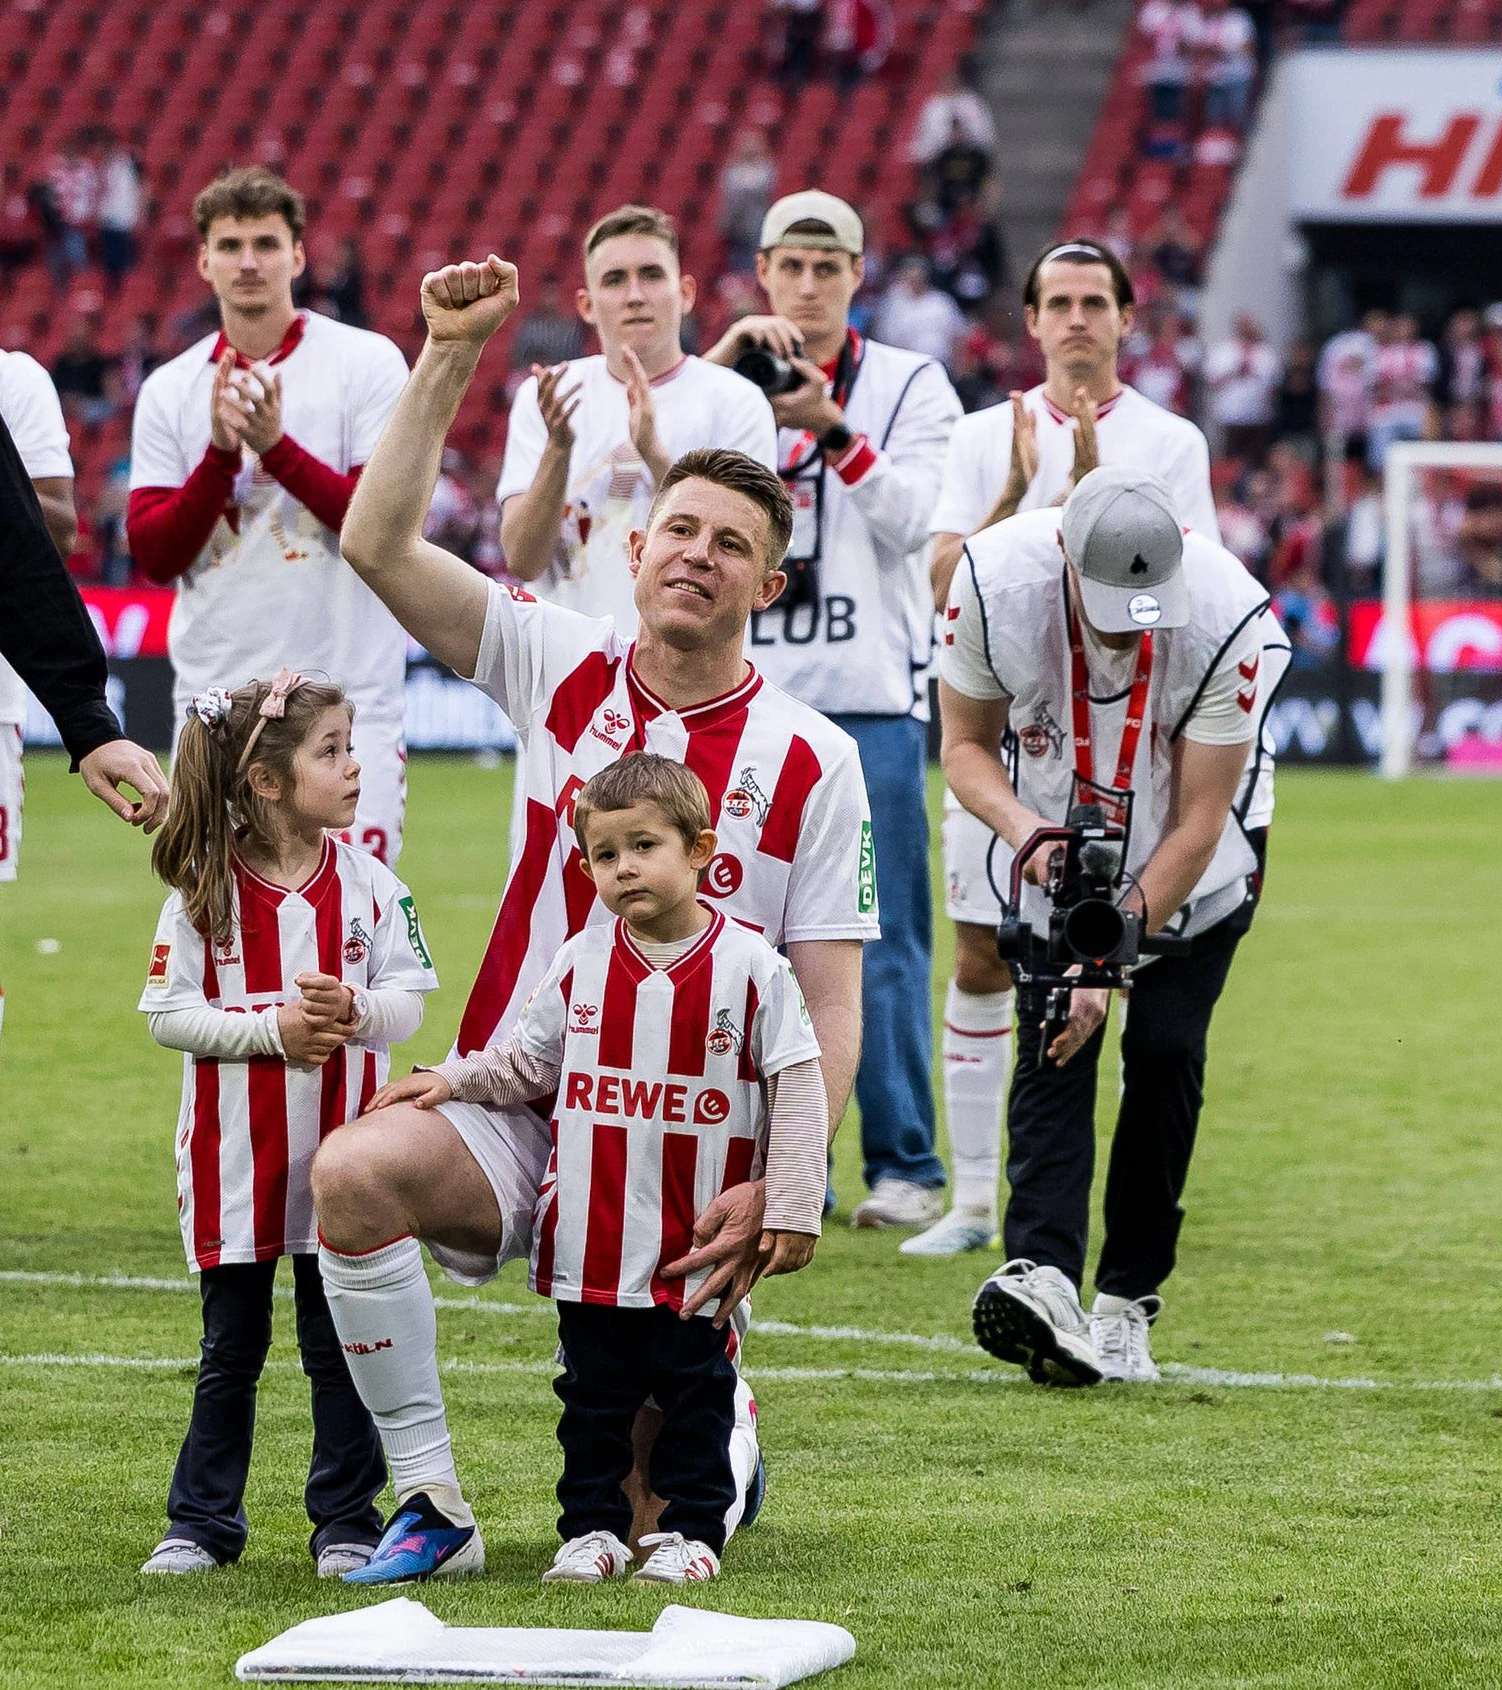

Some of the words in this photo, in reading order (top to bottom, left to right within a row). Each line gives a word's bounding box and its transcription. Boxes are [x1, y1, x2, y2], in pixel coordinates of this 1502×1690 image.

[589, 724, 623, 751] hummel
[861, 830, 873, 906] DEVK
[406, 905, 426, 963] DEVK
[569, 1026, 599, 1035] hummel
[565, 1071, 688, 1123] REWE
